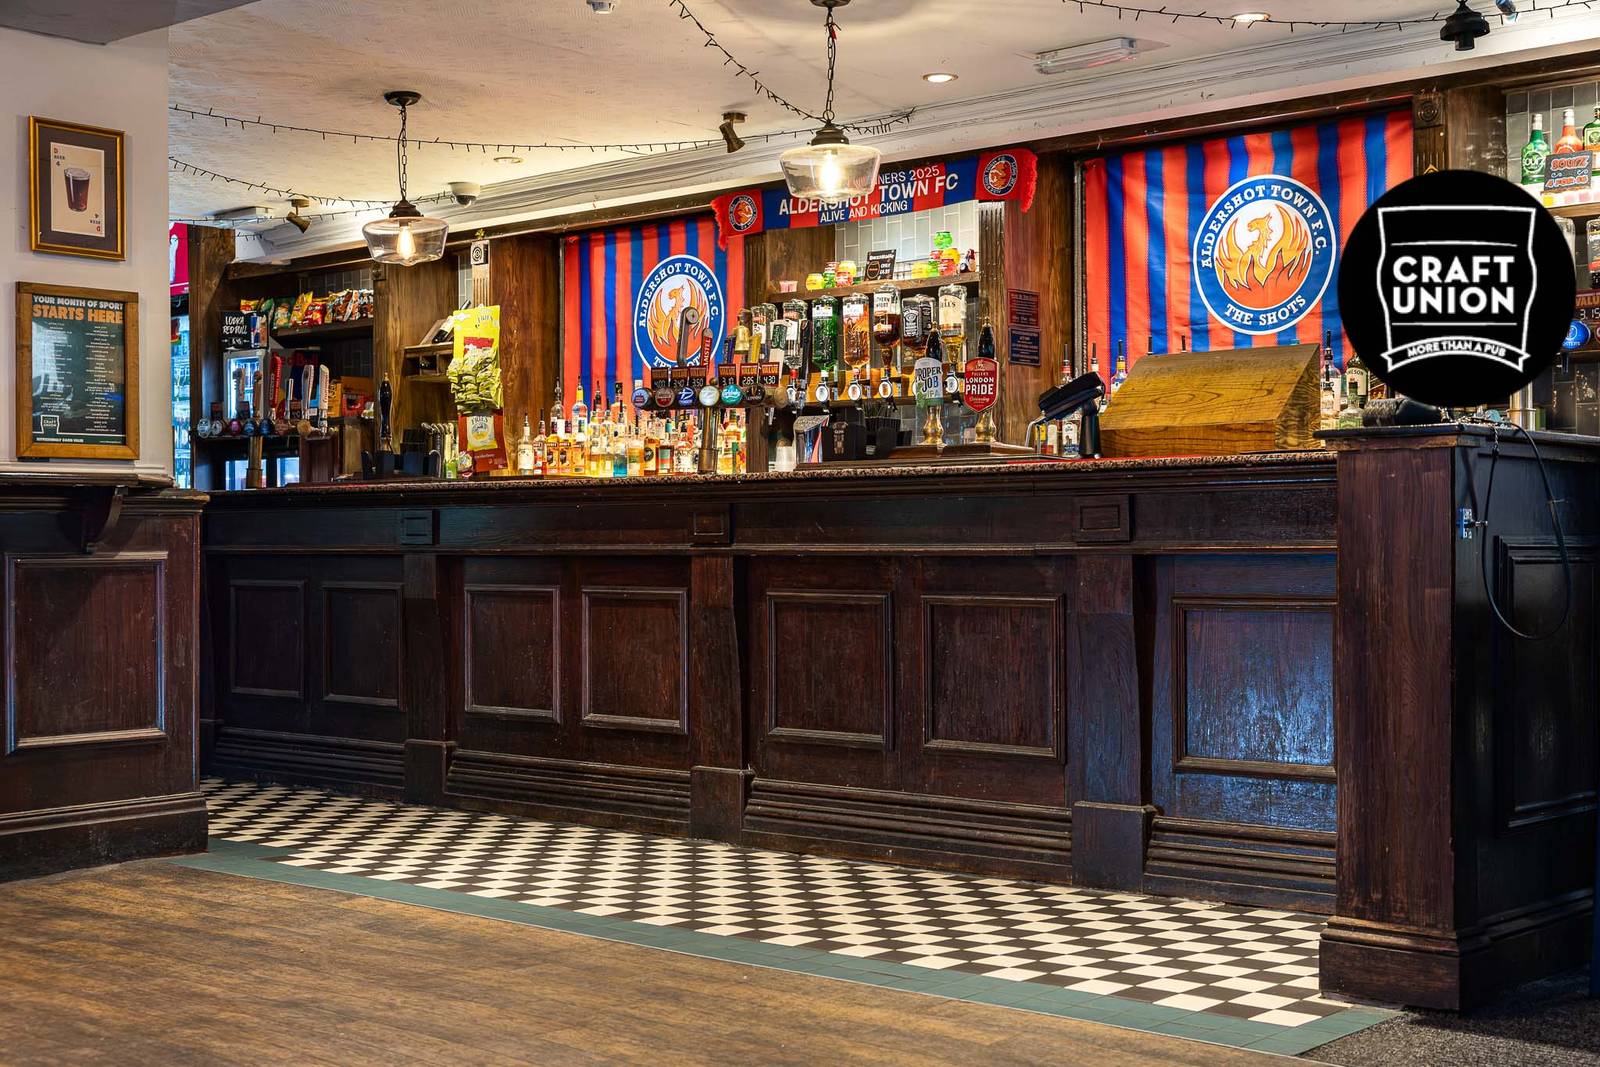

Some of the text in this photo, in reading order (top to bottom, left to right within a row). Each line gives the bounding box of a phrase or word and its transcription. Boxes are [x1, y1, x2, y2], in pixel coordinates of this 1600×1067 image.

[909, 165, 940, 181] 2025
[779, 193, 871, 215] ALDERSHOT
[880, 180, 929, 202] TOWN
[934, 173, 959, 194] FC
[820, 200, 908, 223] ALIVE AND KICKING
[1201, 185, 1265, 269] ALDERSHOT
[1270, 185, 1317, 218] TOWN
[33, 295, 124, 310] YOUR MONTH OF SPORT
[639, 262, 682, 328] ALDERSHOT
[684, 263, 713, 291] TOWN
[33, 304, 123, 324] STARTS HERE
[1224, 295, 1307, 326] THE SHOTS
[922, 376, 939, 392] JOB
[965, 384, 994, 395] PRIDE
